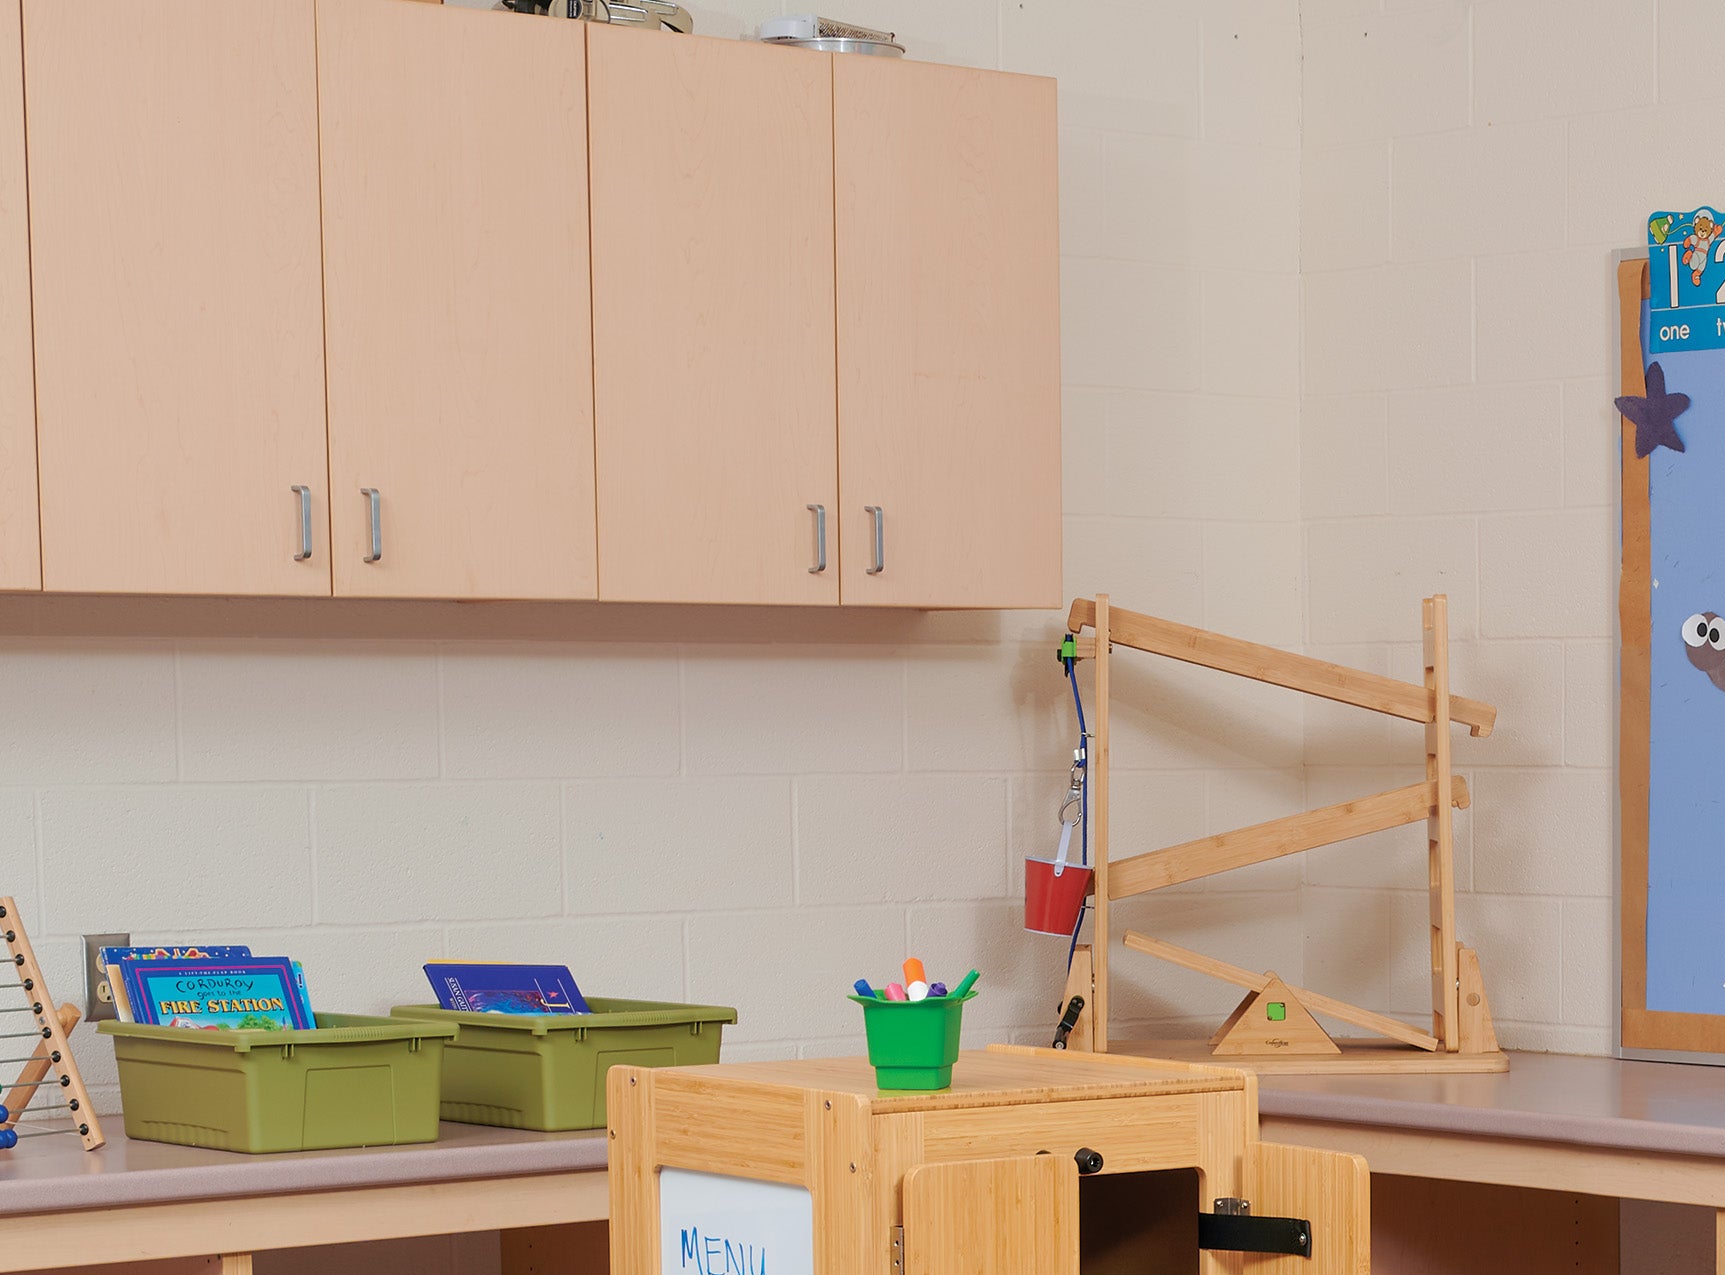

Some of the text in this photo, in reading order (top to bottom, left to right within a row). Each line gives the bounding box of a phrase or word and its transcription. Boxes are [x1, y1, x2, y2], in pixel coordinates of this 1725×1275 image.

[1667, 244, 1681, 308] 1
[1659, 324, 1690, 342] one
[176, 977, 254, 993] CORDUROY
[197, 988, 243, 1001] goes to the
[159, 997, 285, 1015] FIRE STATION
